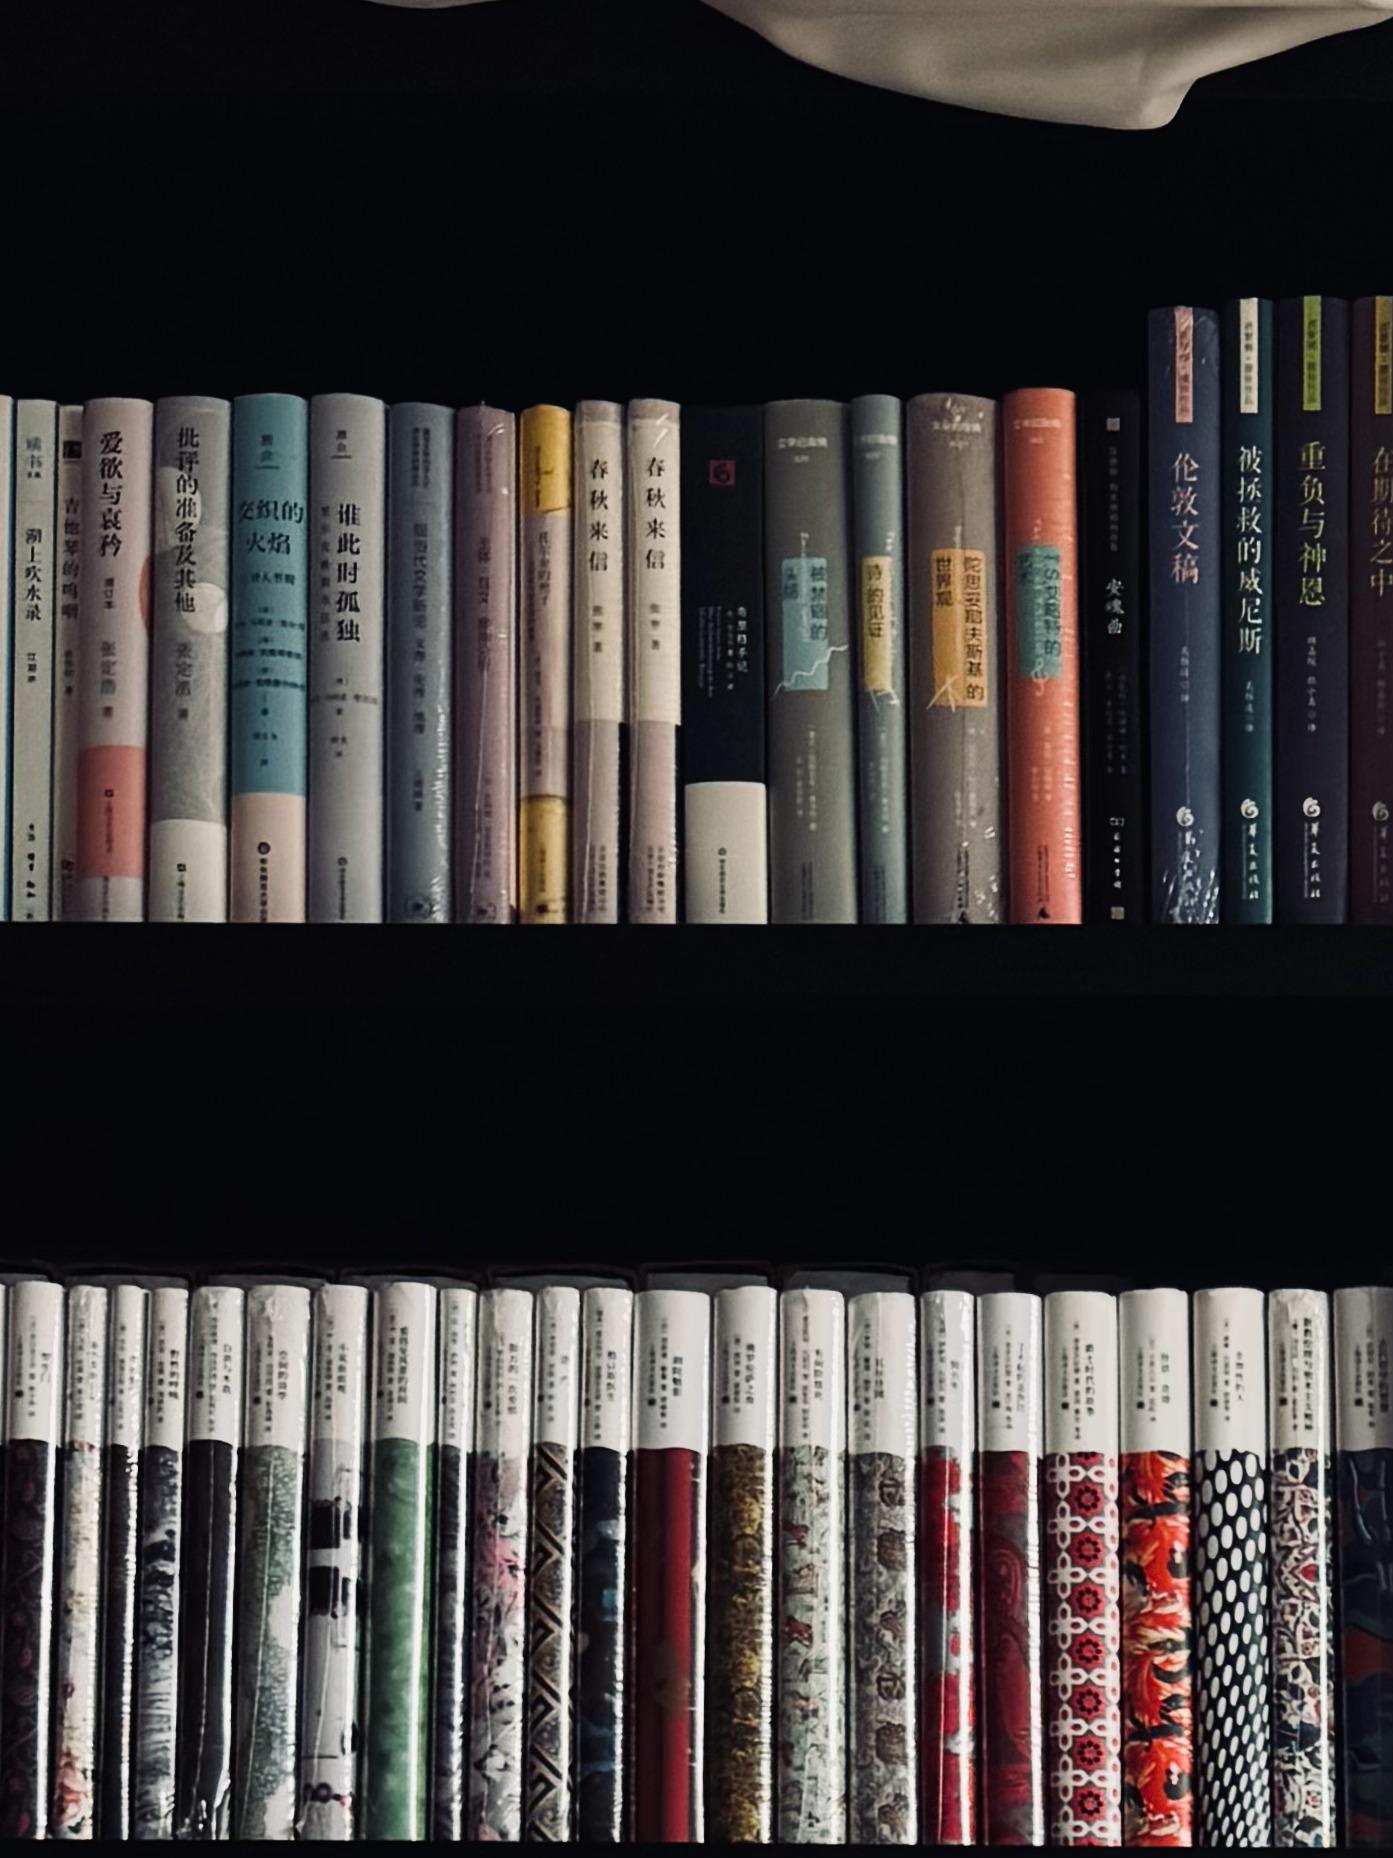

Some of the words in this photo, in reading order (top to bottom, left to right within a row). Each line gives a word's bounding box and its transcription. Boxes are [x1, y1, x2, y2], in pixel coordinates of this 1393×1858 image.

[99, 431, 124, 559] 爱欲与哀矜
[173, 427, 200, 614] 批评的准备及其他
[238, 500, 305, 523] 交织的
[246, 532, 292, 555] 火焰
[589, 459, 609, 572] 春秋来信
[1170, 453, 1200, 585] 伦敦文稿
[1236, 445, 1265, 656] 被拯救的威尼斯
[1298, 442, 1327, 607] 重负与神恩
[335, 504, 362, 643] 谁此时孤独
